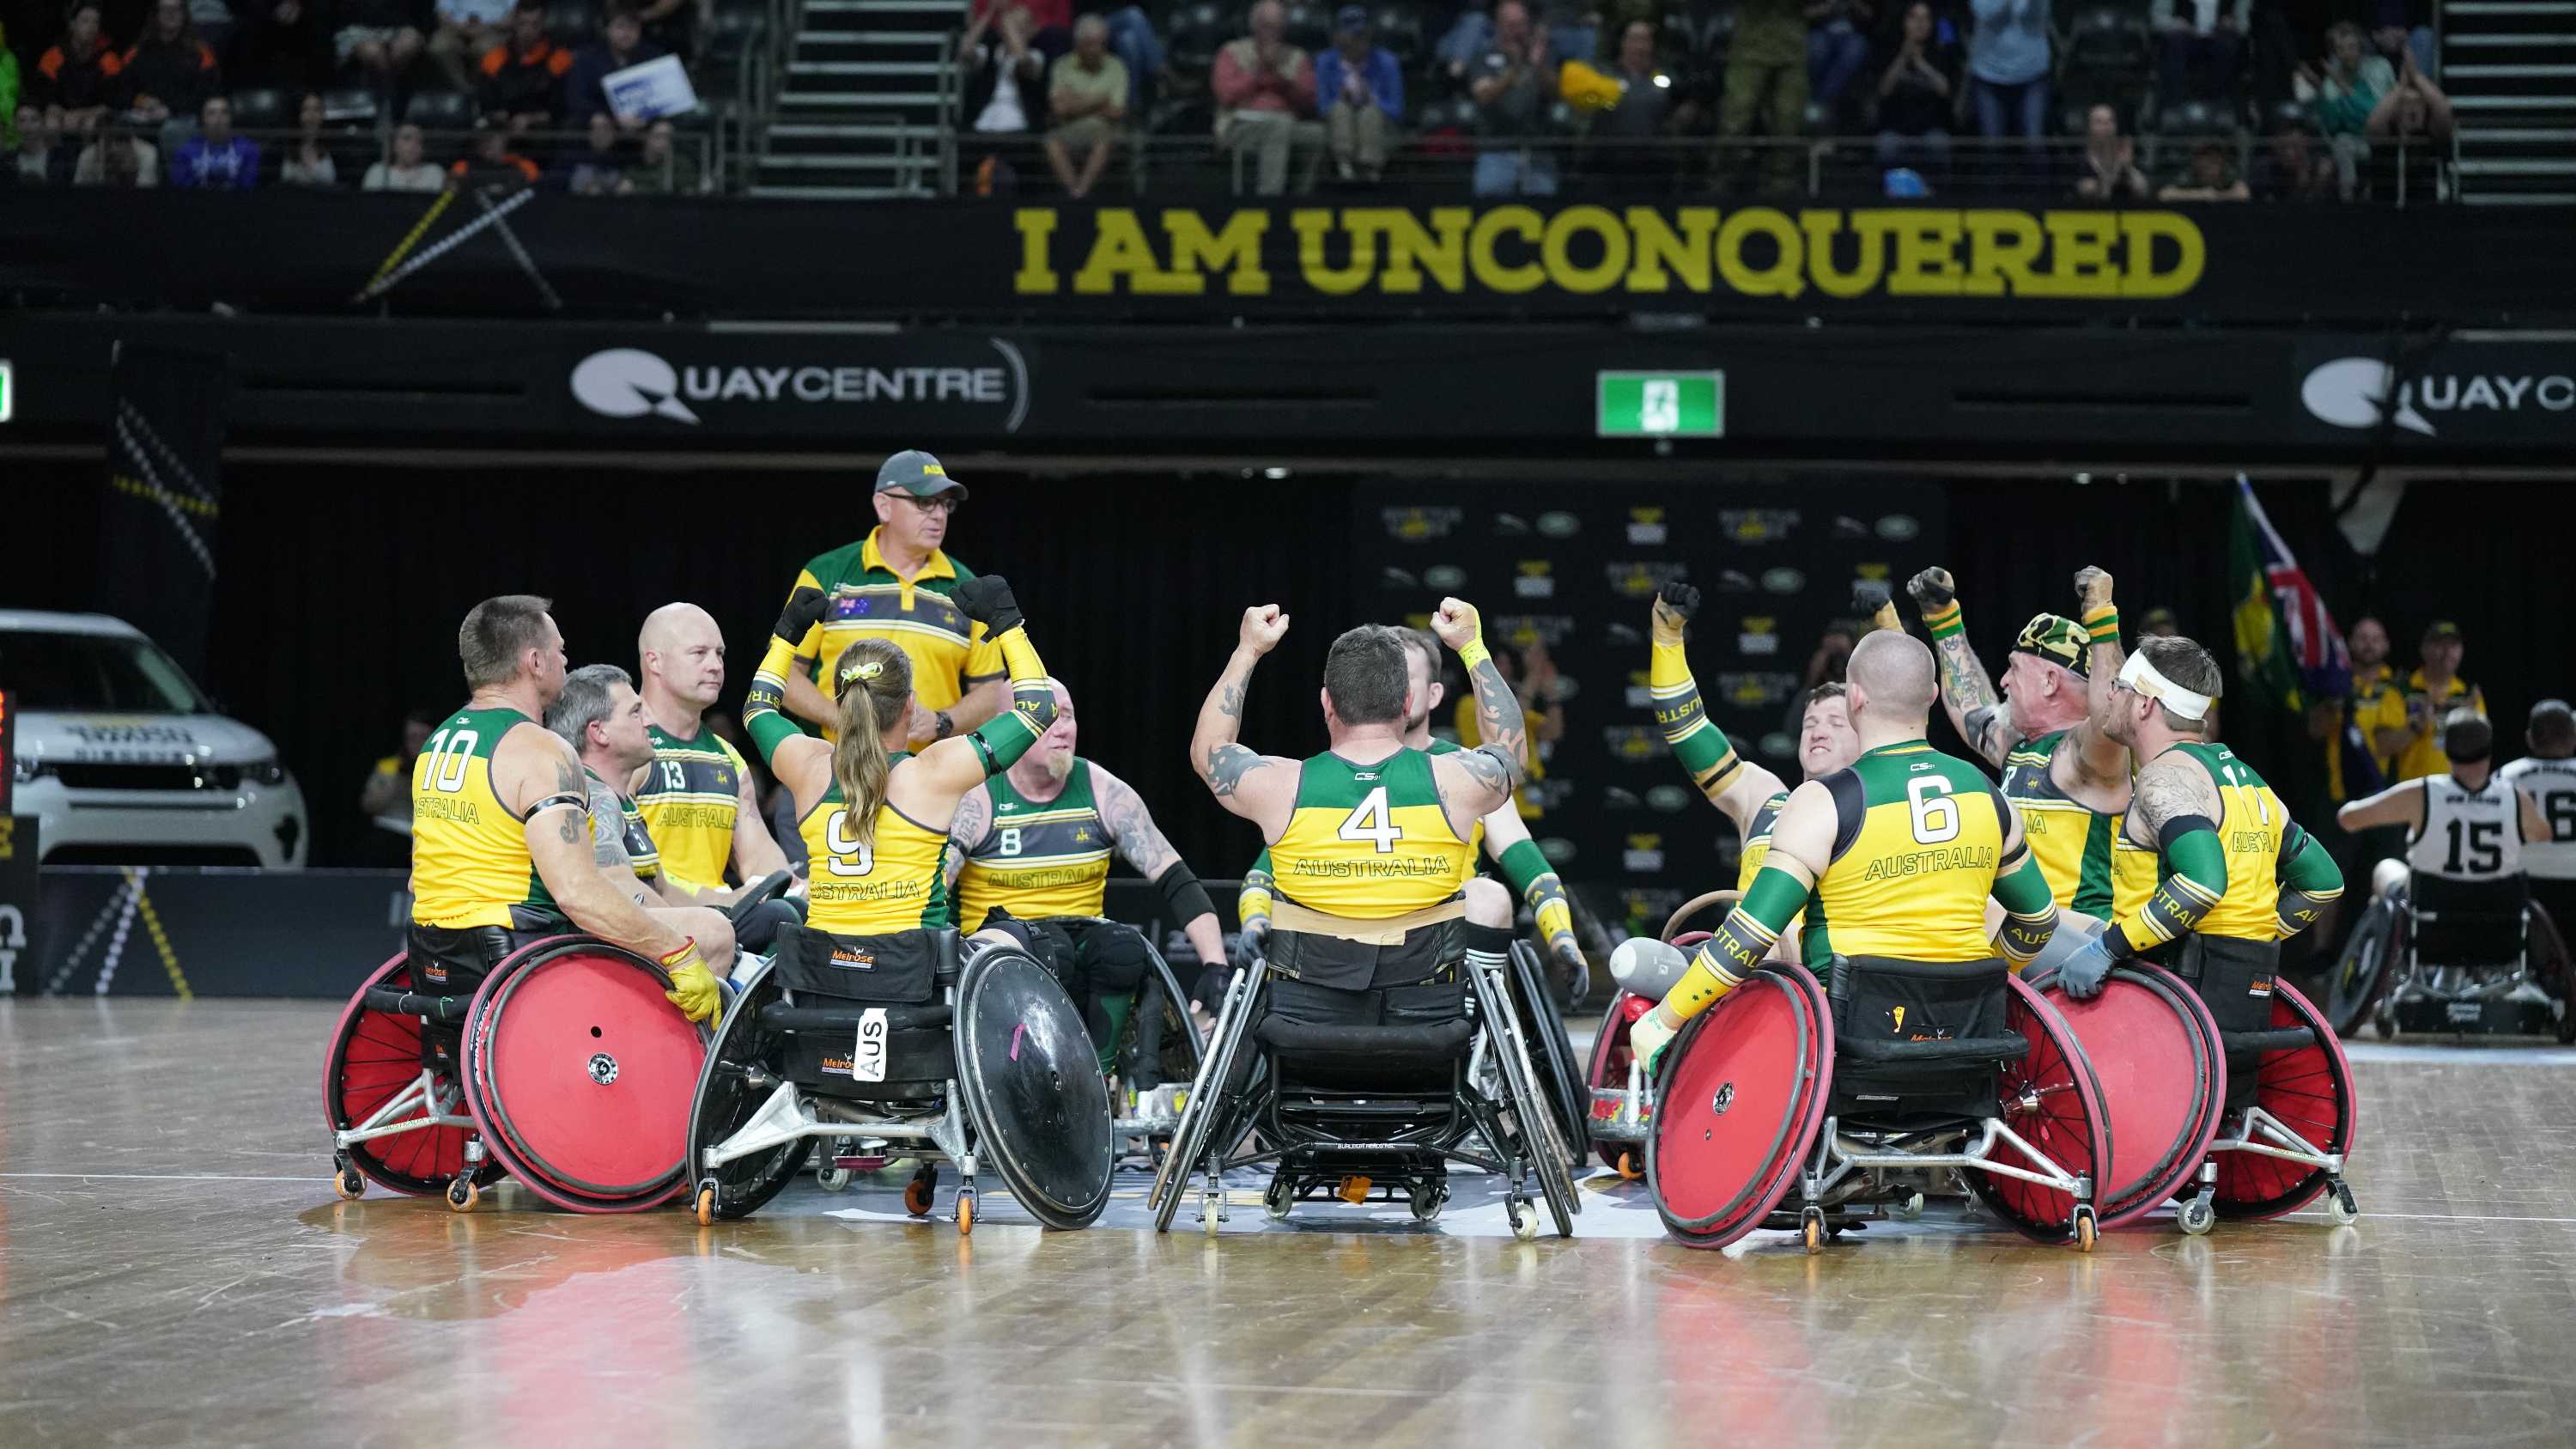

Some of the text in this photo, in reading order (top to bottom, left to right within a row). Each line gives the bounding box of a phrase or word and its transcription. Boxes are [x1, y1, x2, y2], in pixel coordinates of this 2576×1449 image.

[1015, 205, 2206, 298] I AM UNCONQUERED
[422, 728, 478, 793] 10
[660, 761, 685, 788] 13
[1338, 786, 1403, 853] 4
[1907, 775, 1959, 844] 6
[827, 809, 874, 876] 9
[1000, 828, 1022, 855] 8
[1293, 855, 1450, 877] AUSTRALIA
[1865, 846, 1993, 881] AUSTRALIA
[2444, 818, 2502, 874] 15
[860, 1021, 882, 1077] AUS
